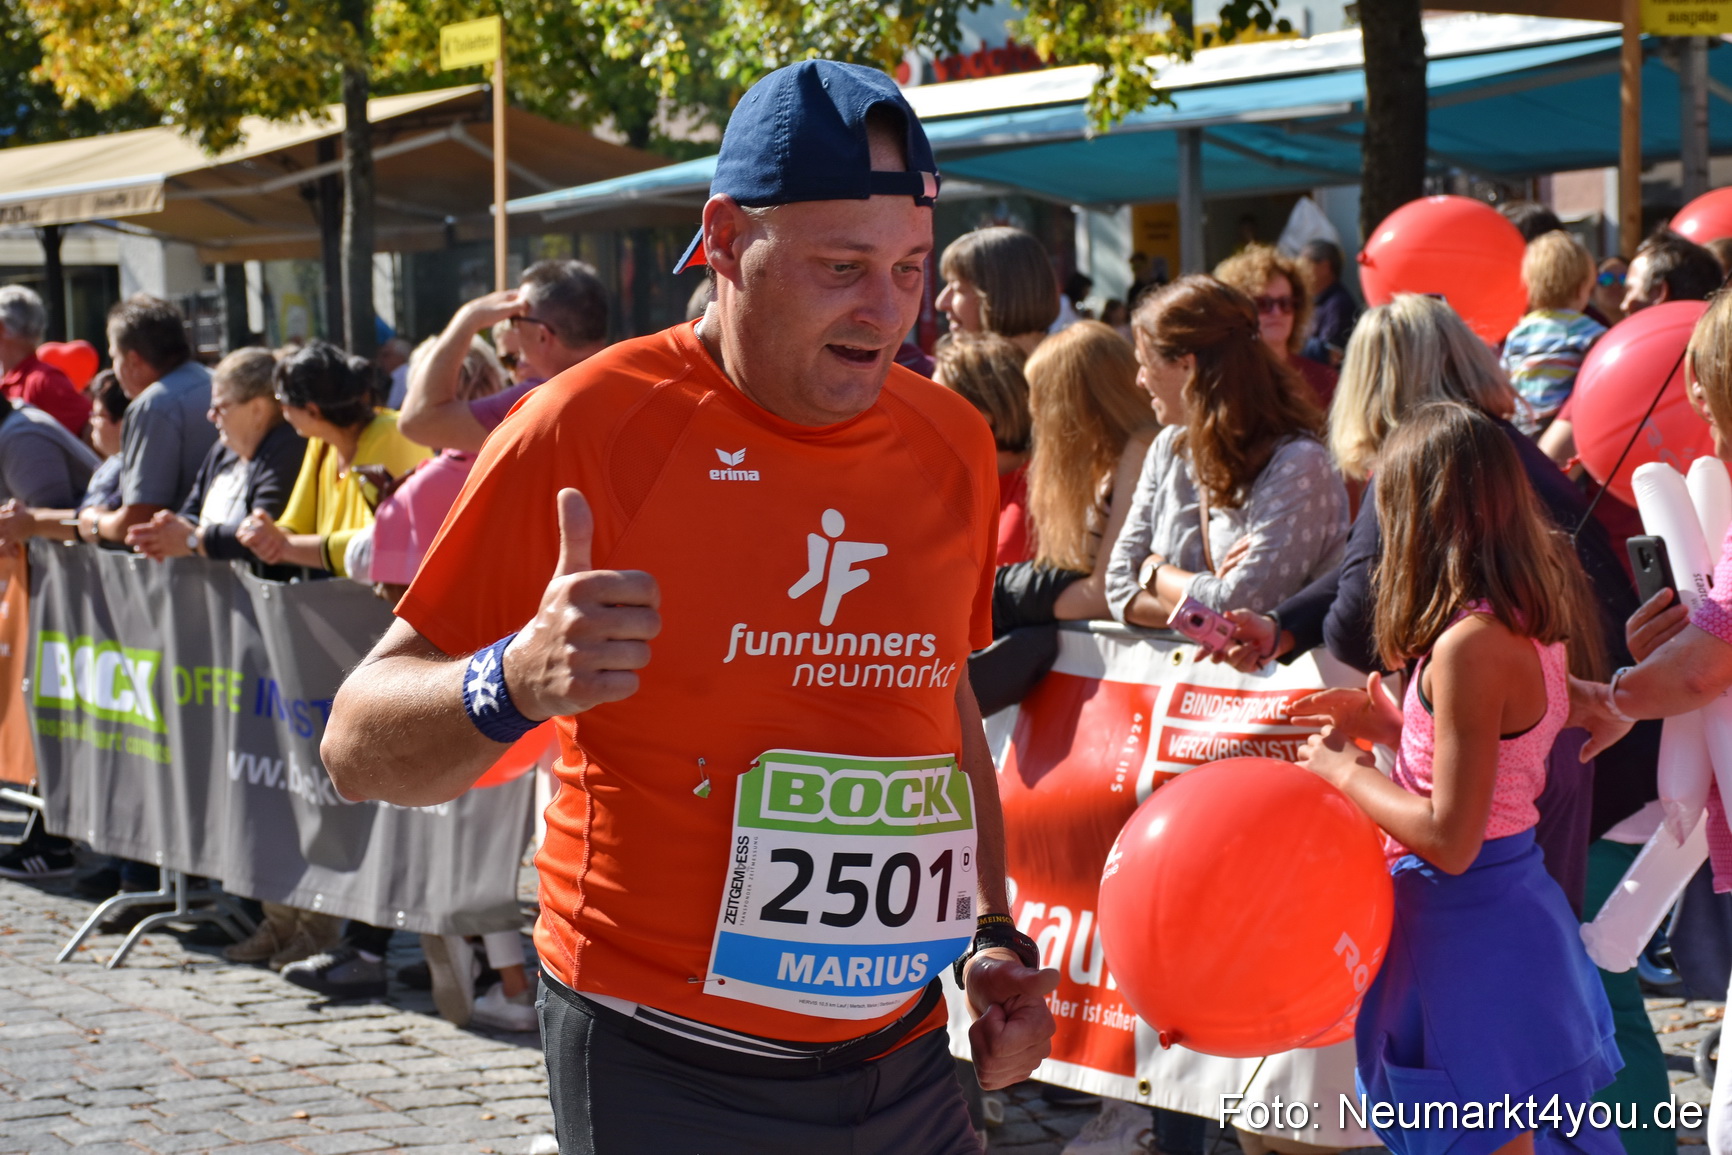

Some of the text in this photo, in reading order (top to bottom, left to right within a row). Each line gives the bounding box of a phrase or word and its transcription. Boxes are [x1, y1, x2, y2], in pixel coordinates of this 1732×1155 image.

[709, 467, 760, 482] erima
[723, 622, 936, 663] funrunners
[791, 658, 956, 688] neumarkt
[1179, 690, 1289, 723] BINDESTRICKE
[1110, 712, 1144, 793] Seit 1929
[764, 766, 957, 822] BOCK
[962, 851, 971, 867] D
[760, 848, 953, 928] 2501
[776, 952, 929, 987] MARIUS
[1082, 999, 1103, 1024] ist
[1102, 1001, 1137, 1032] sicher
